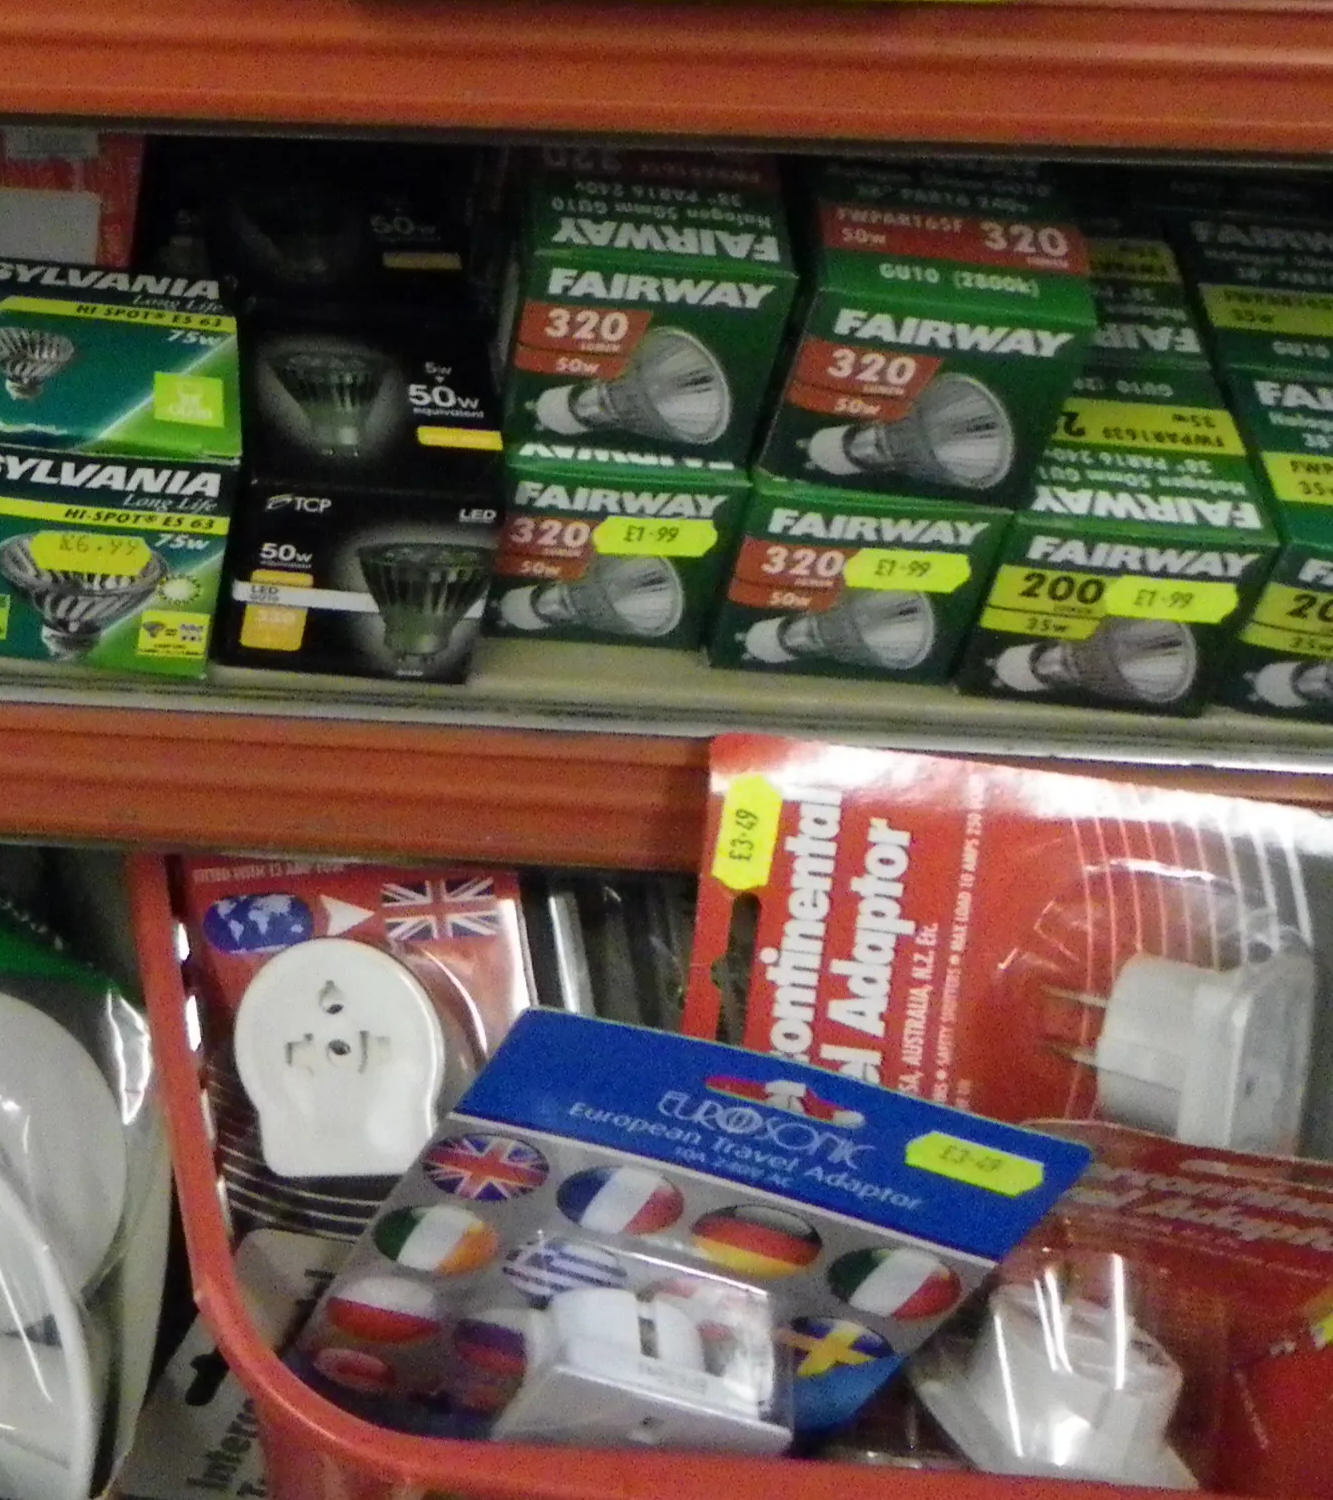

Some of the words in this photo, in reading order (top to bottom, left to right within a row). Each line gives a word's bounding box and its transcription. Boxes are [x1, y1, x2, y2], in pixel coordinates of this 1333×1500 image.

[550, 216, 781, 263] FAIRWAY
[979, 220, 1070, 258] 320
[547, 267, 778, 309] FAIRWAY
[878, 262, 941, 285] GU10
[544, 307, 630, 343] 320
[833, 307, 1076, 358] FAIRWAY
[826, 347, 918, 386] 320
[407, 383, 481, 410] 50w
[122, 492, 176, 512] Long
[293, 495, 333, 514] TCP
[458, 508, 498, 522] LED
[514, 479, 732, 517] FAIRWAY
[1028, 484, 1263, 530] FAIRWAY
[161, 514, 184, 528] ES
[190, 517, 215, 530] 63
[510, 520, 591, 547] 320
[766, 507, 991, 547] FAIRWAY
[153, 533, 211, 550] 75w
[258, 542, 314, 564] 50w
[1025, 534, 1262, 578] FAIRWAY
[760, 545, 846, 578] 320
[1018, 571, 1107, 605] 200
[954, 890, 974, 923] LOAD
[761, 791, 844, 1062] ontinental
[826, 815, 917, 1039] Adaptor
[900, 981, 933, 1066] AUSTRALIA,
[568, 1101, 702, 1148] European
[709, 1134, 800, 1173] Travel
[803, 1158, 926, 1210] Adaptor
